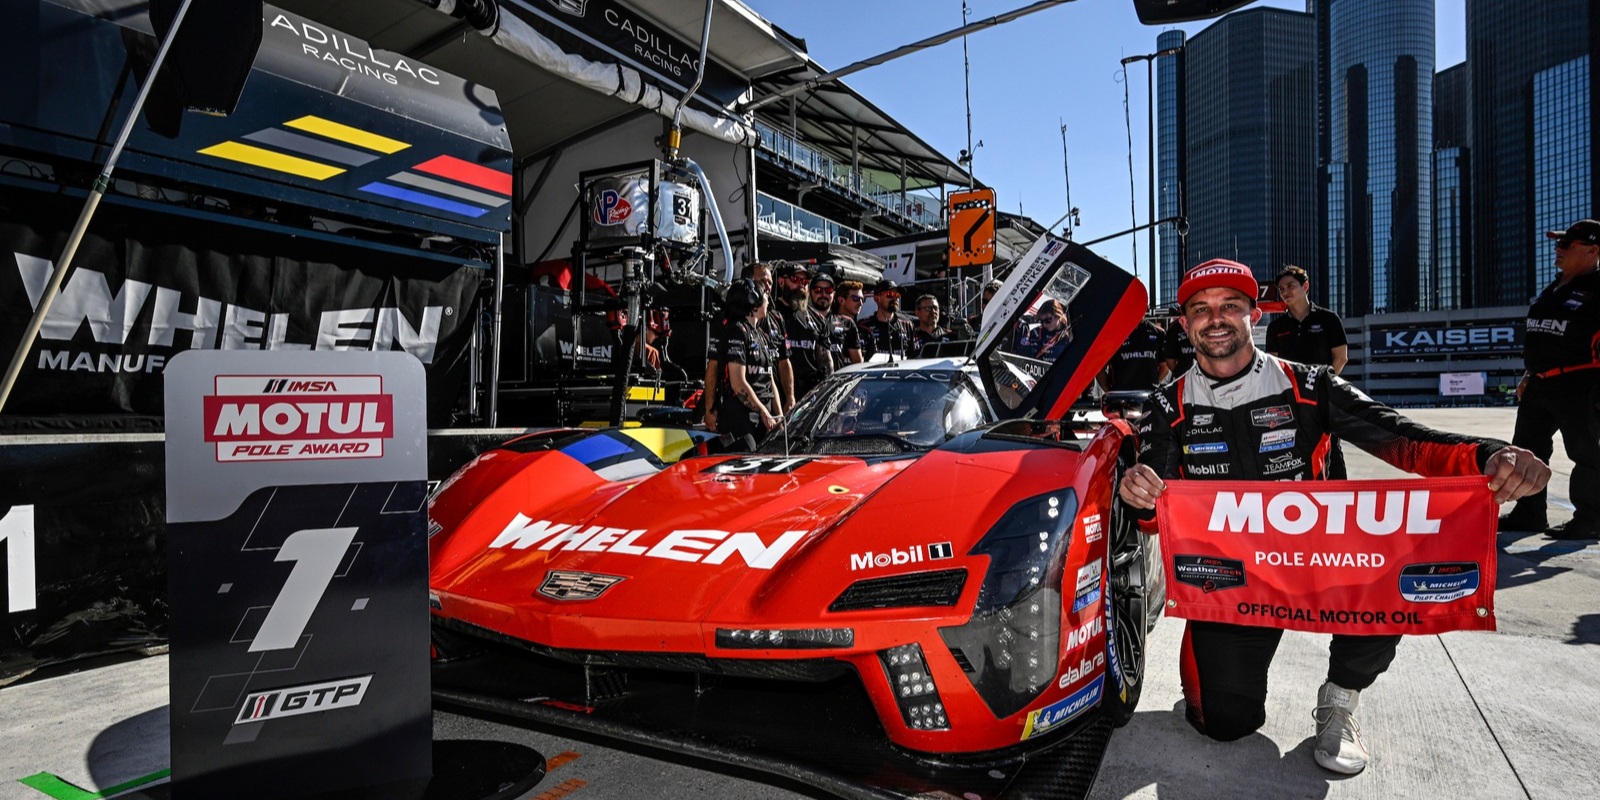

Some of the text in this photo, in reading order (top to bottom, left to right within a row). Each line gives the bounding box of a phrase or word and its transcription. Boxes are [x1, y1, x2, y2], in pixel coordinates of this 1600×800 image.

[263, 14, 440, 85] ADILLAC
[302, 43, 398, 85] RACING
[634, 43, 681, 77] RACING
[901, 252, 914, 276] 7
[1011, 256, 1043, 296] BAMBER
[1020, 257, 1049, 295] AITKEN
[1259, 286, 1269, 298] 7
[14, 252, 443, 364] WHELEN
[1386, 327, 1515, 347] KAISER
[38, 350, 165, 373] MANUF
[287, 381, 338, 392] IMSA
[213, 402, 386, 436] MOTUL
[232, 443, 370, 456] POLE AWARD
[1188, 464, 1216, 475] Mobil
[1207, 490, 1441, 535] MOTUL
[488, 512, 808, 570] WHELEN
[851, 545, 924, 571] Mobil
[1177, 565, 1242, 576] WeatherTech
[1254, 550, 1386, 568] POLE AWARD
[248, 527, 359, 653] 1
[1429, 578, 1468, 588] MICHELIN
[1236, 601, 1423, 625] OFFICIAL MOTOR OIL
[1066, 615, 1103, 652] MOTUL
[1059, 651, 1104, 690] dallara
[280, 683, 362, 712] GTP
[1052, 685, 1099, 722] MICHELIN
